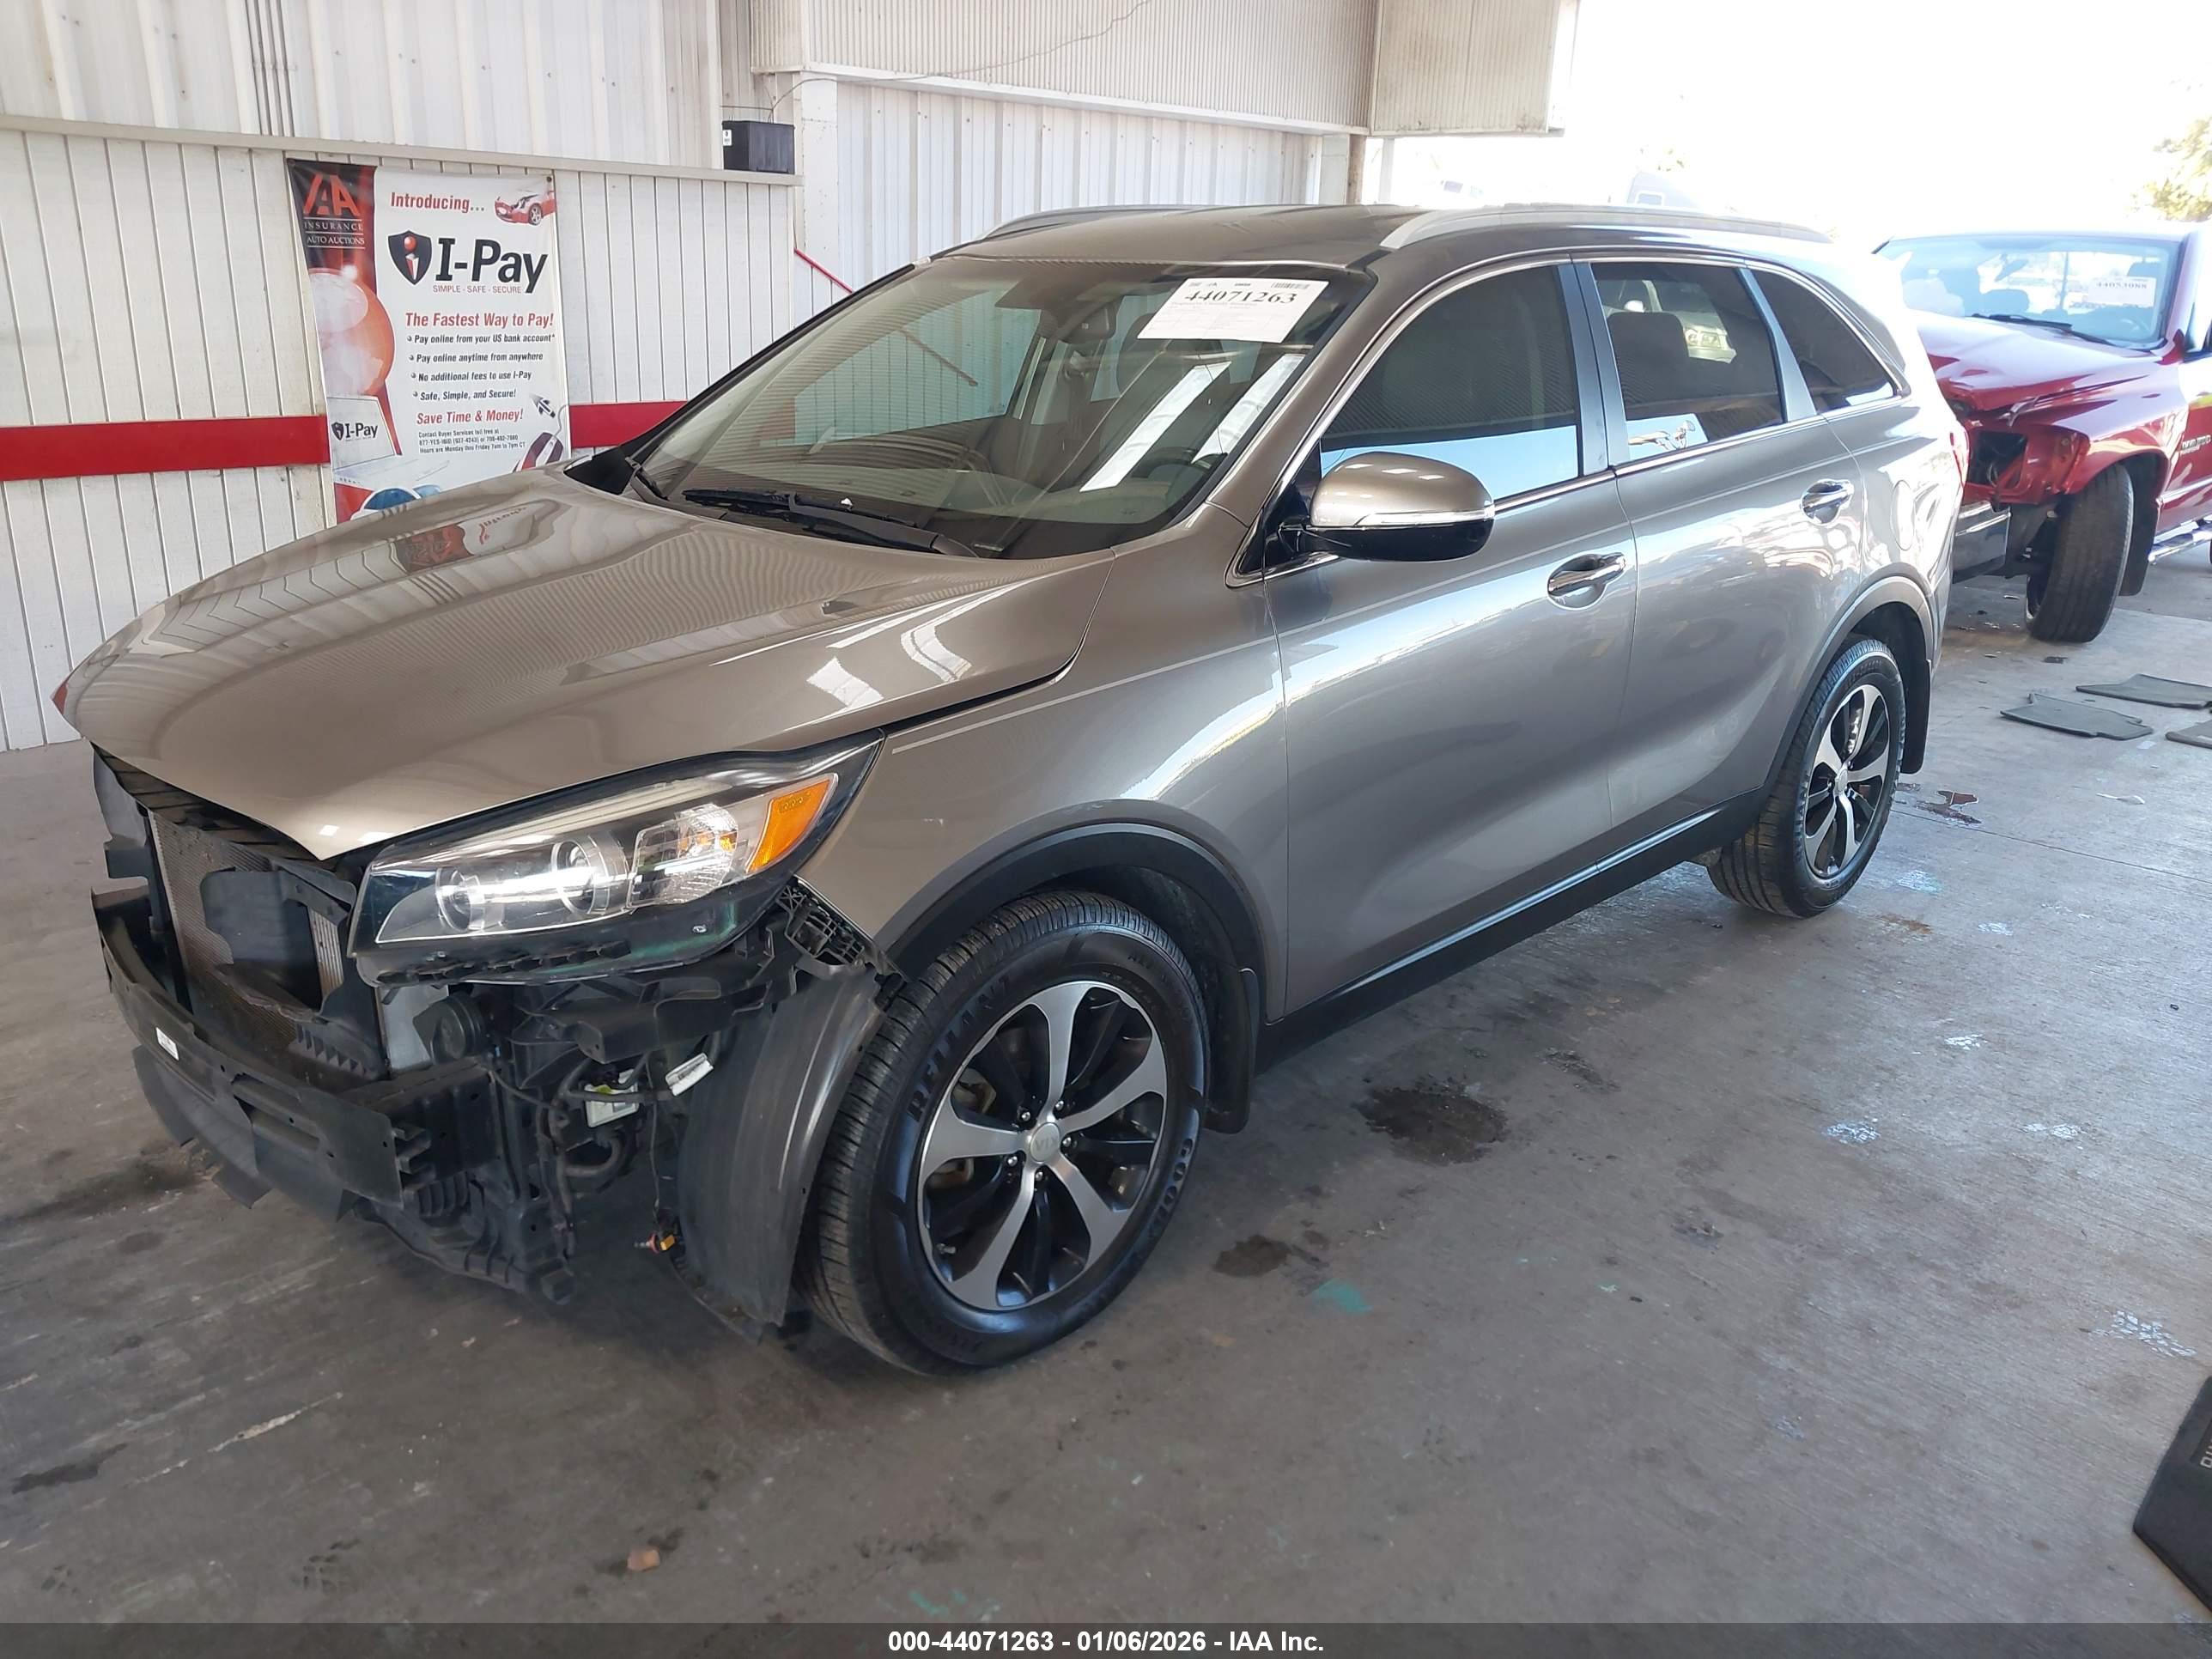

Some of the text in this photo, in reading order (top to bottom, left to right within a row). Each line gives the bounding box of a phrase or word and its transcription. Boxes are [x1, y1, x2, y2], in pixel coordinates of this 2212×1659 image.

[391, 191, 485, 214] Introducing...
[304, 221, 364, 232] INSURANCE
[307, 235, 365, 245] AUTO AUCTIONS
[435, 237, 549, 294] I-Pay
[433, 285, 461, 294] SIMPLE
[467, 285, 486, 294] SAFE
[492, 286, 522, 295] SECURE
[1184, 289, 1298, 304] 44071263
[405, 313, 554, 329] The Fastest Way to Pay!
[414, 334, 428, 345] Pay
[430, 334, 454, 343] online
[456, 334, 473, 343] from
[475, 336, 490, 345] your
[493, 334, 502, 343] US
[503, 333, 521, 343] bank
[416, 352, 544, 364] Pay online anytime from anywhere
[418, 373, 428, 382] No
[430, 372, 469, 381] additional
[471, 372, 488, 380] fees
[489, 371, 496, 380] to
[513, 370, 532, 380] I-Pay
[420, 389, 517, 402] Safe, Simple, and Secure!
[416, 408, 524, 425] Save Time & Money!
[344, 422, 379, 439] I-Pay
